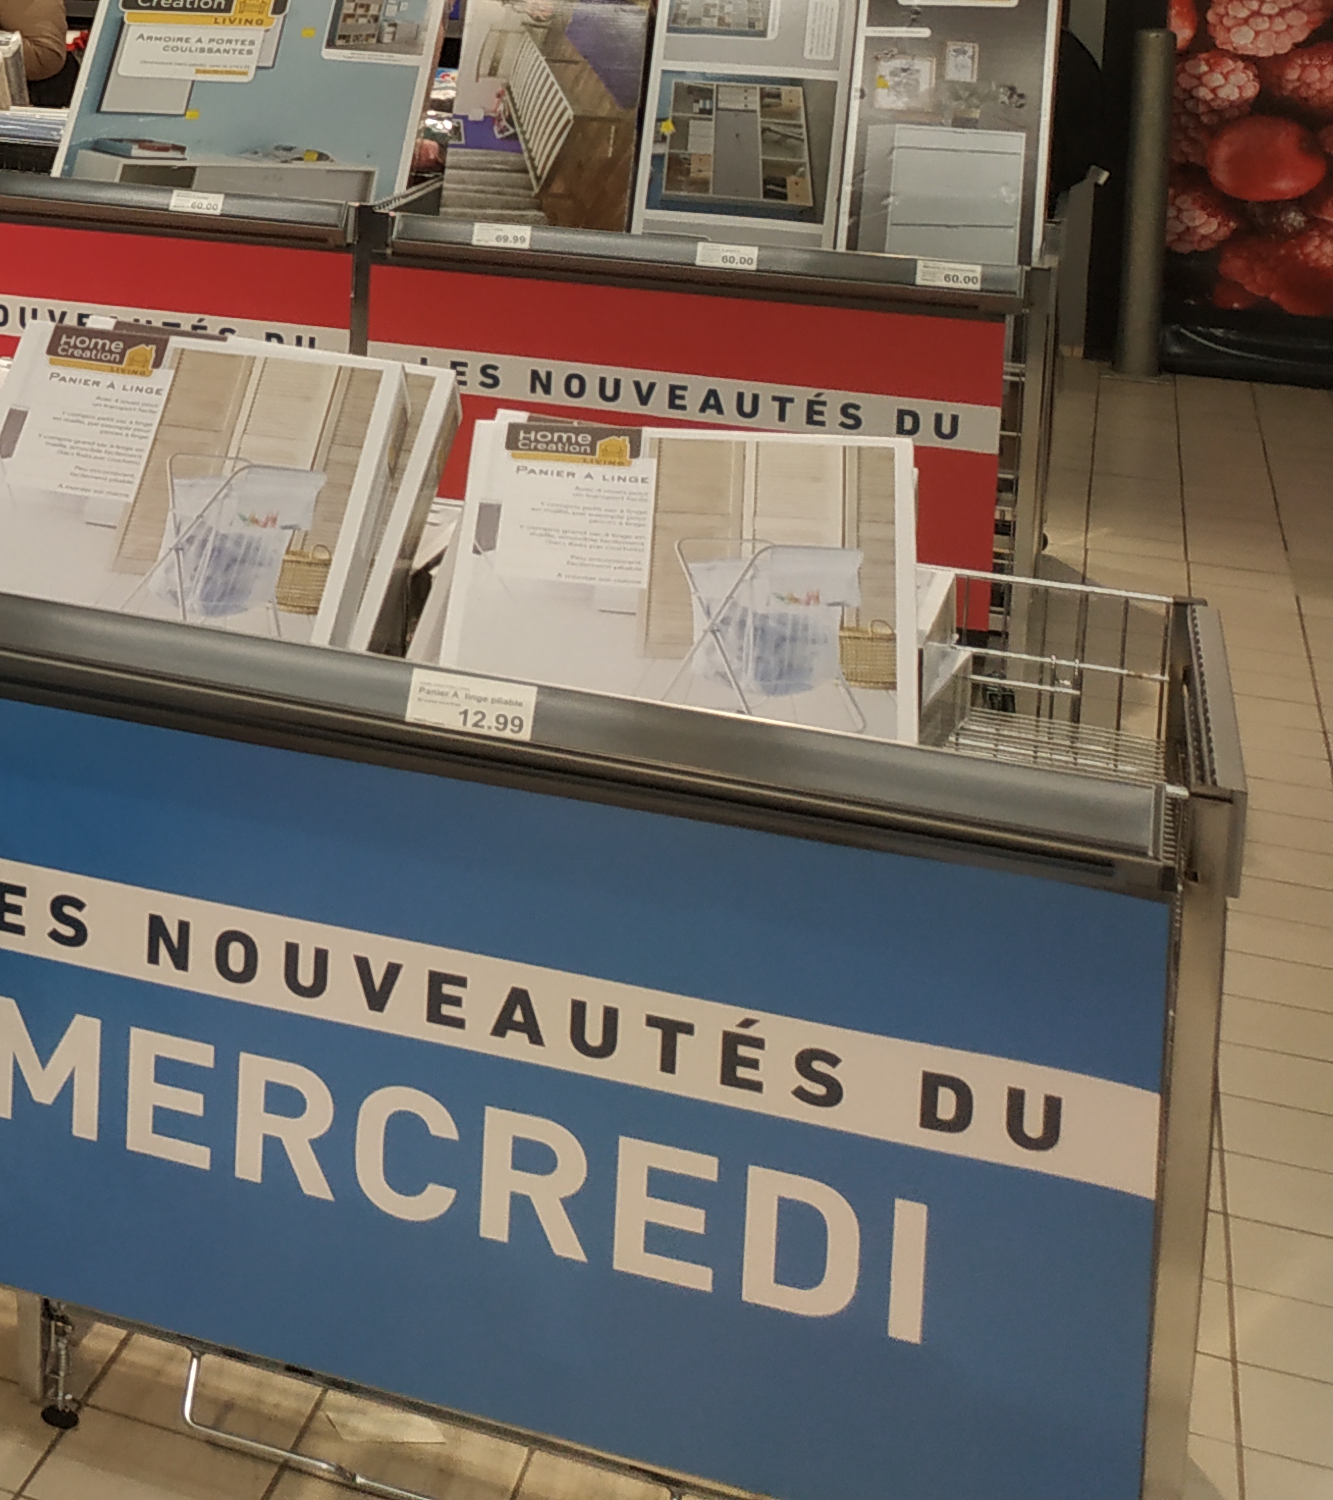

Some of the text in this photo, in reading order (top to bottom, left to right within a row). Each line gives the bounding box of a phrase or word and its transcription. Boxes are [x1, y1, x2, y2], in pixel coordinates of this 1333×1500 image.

[213, 16, 264, 26] LIVING
[495, 234, 526, 244] 69.99
[721, 254, 754, 266] 60.00
[943, 273, 979, 285] 60.00
[60, 334, 124, 353] Home
[57, 345, 120, 363] Creation
[529, 367, 863, 432] NOUVEAUTÉS
[896, 408, 960, 441] DU
[519, 430, 592, 445] Home
[517, 440, 591, 454] Creation
[418, 686, 450, 698] Panier
[464, 692, 489, 705] linge
[490, 696, 524, 708] pliable
[458, 708, 524, 735] 12.99
[145, 915, 846, 1110] NOUVEAUTÉS
[919, 1068, 1064, 1154] DU
